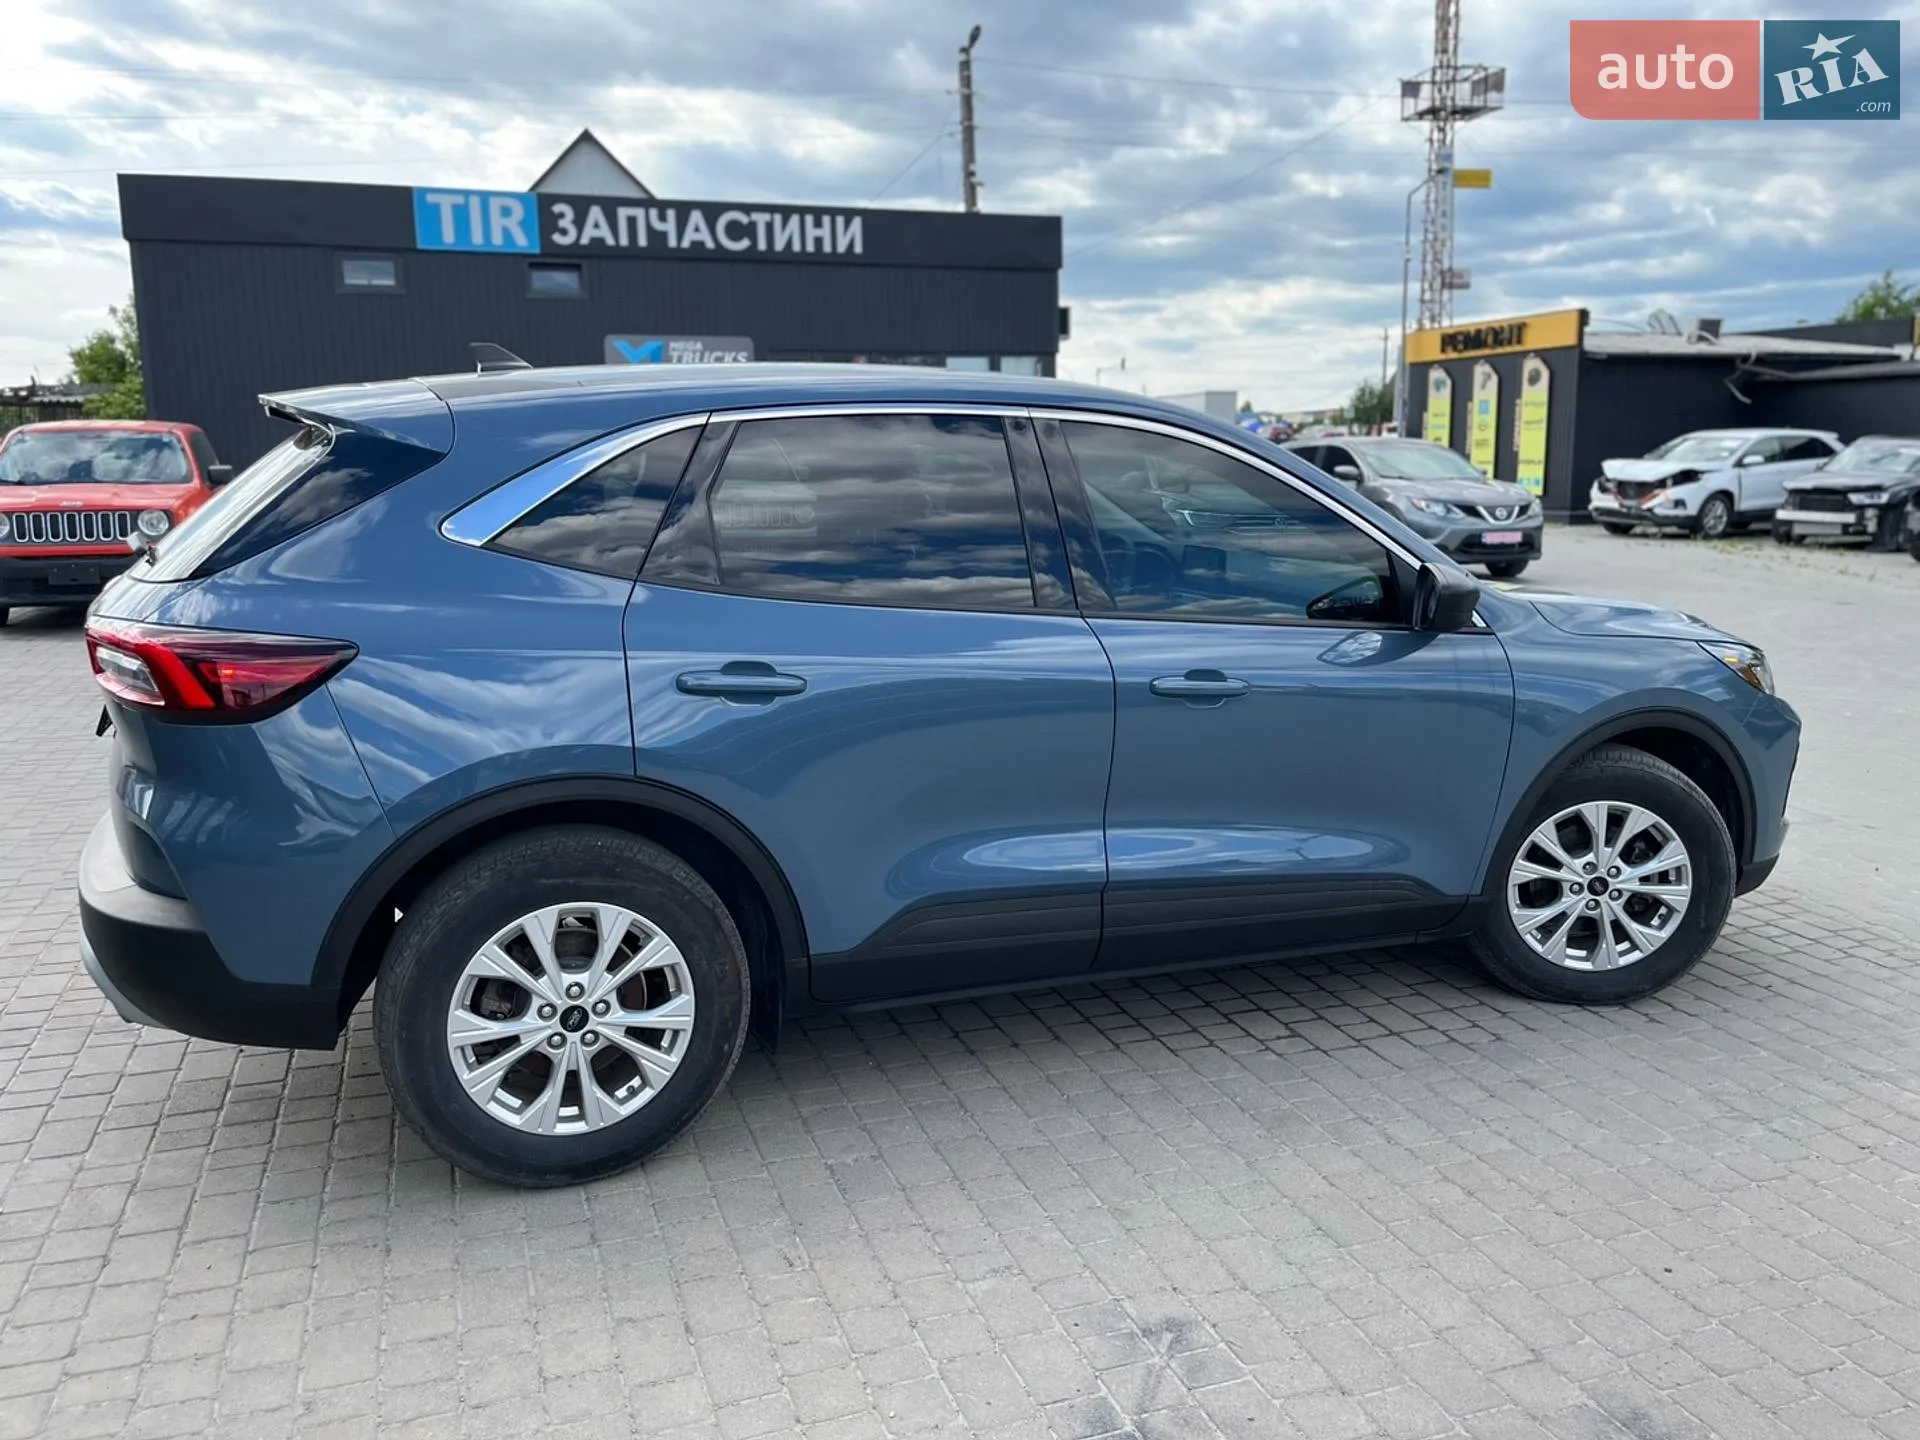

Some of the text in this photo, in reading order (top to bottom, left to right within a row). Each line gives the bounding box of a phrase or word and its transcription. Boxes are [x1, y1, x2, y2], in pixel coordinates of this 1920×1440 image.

[427, 193, 528, 248] TIR
[550, 203, 864, 254] ЗАПЧАСТИНИ
[669, 341, 703, 351] MEGA
[1440, 322, 1526, 353] РЕМОНТ
[669, 351, 749, 364] TRUCKS
